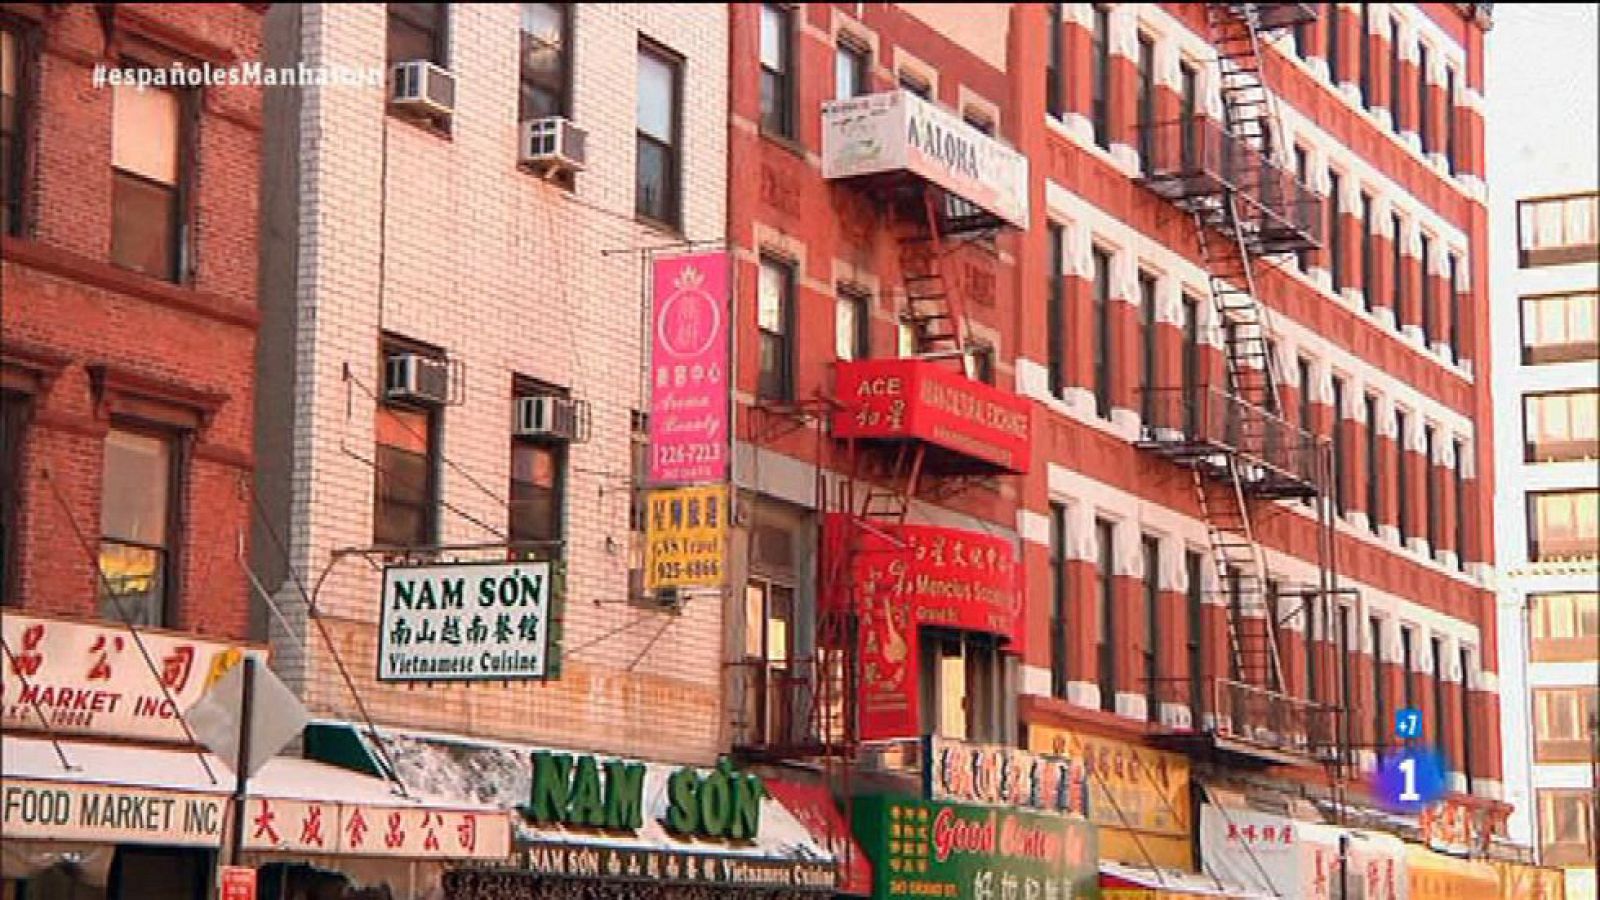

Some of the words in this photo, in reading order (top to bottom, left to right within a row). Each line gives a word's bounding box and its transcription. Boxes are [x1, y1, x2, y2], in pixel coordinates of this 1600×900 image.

[857, 377, 900, 398] ACE
[393, 578, 464, 609] NAM
[389, 653, 474, 673] Vietnamese
[480, 650, 537, 672] Cuisine
[19, 684, 121, 713] MARKET
[531, 750, 646, 829] NAM
[4, 787, 70, 826] FOOD
[80, 793, 175, 832] MARKET
[934, 807, 996, 862] Good
[529, 848, 565, 873] NAM
